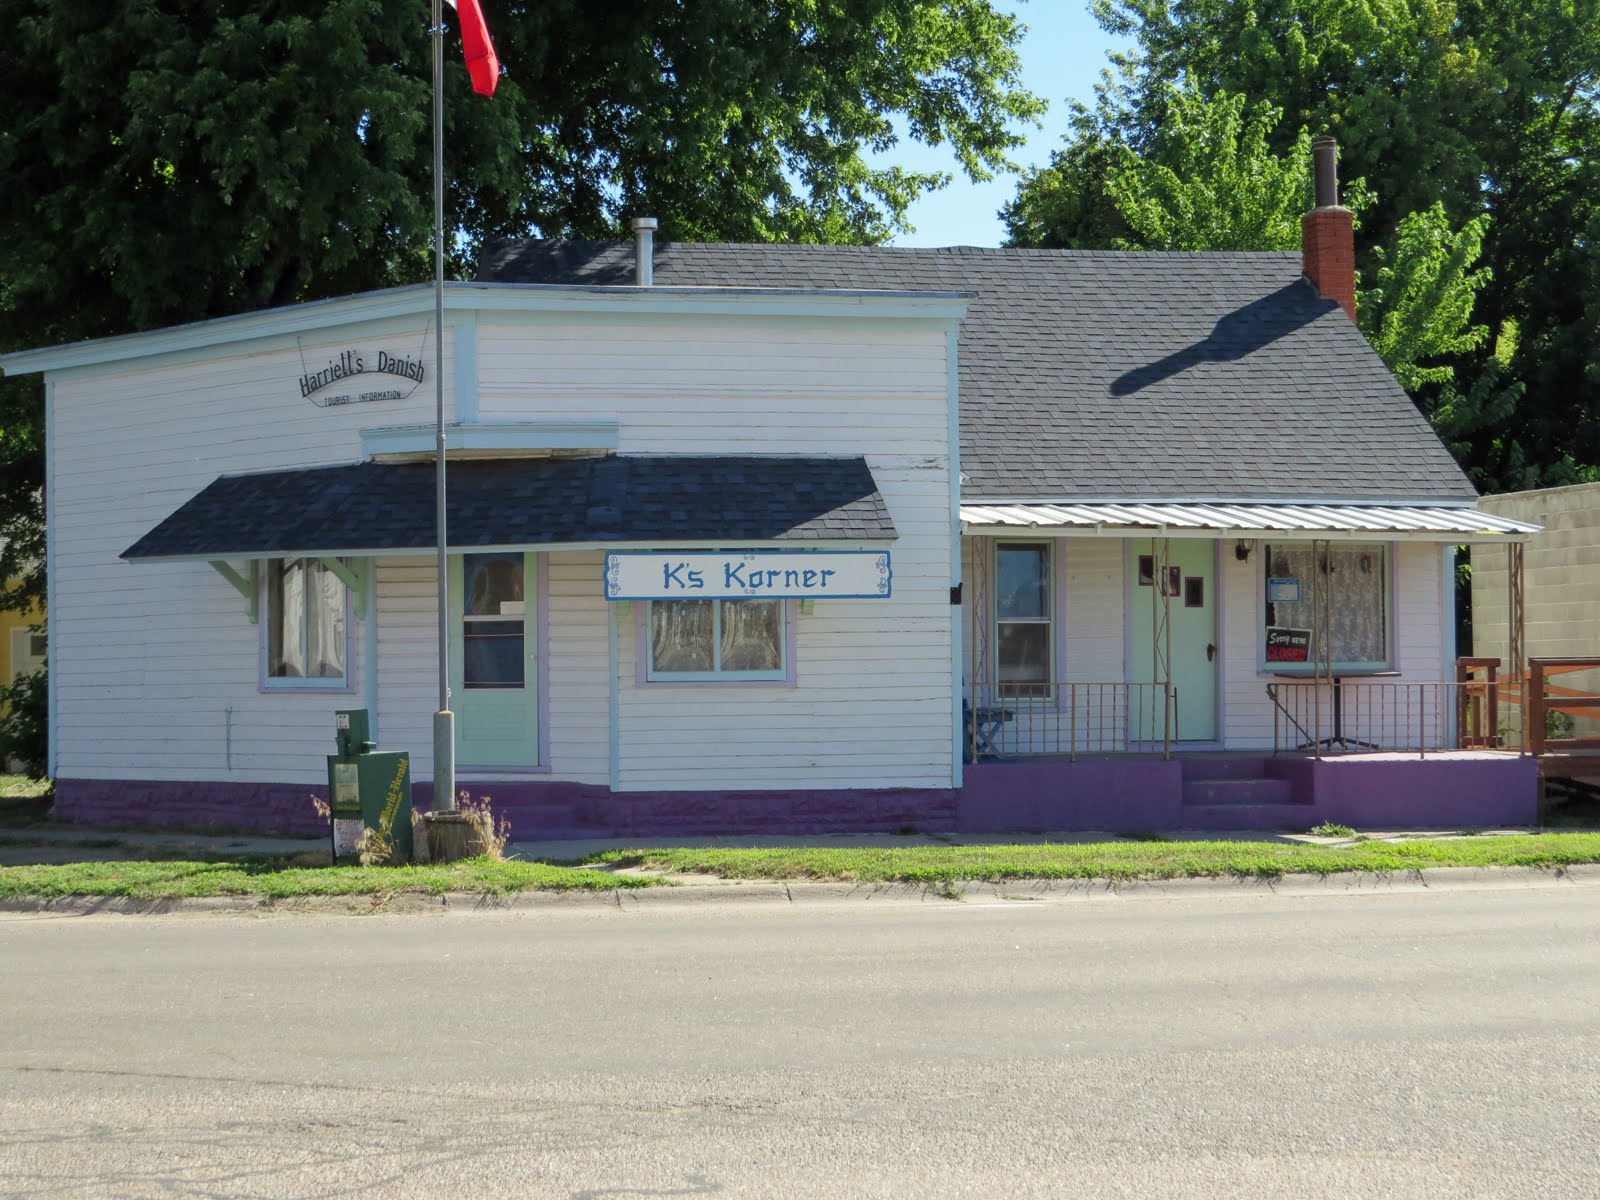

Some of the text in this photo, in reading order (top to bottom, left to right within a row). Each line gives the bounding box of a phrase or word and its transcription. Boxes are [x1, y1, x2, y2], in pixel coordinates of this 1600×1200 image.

[299, 350, 425, 398] Harriett's Danish
[324, 390, 401, 407] TOURIST INFORMATION
[663, 562, 836, 589] K's Korner
[1269, 632, 1290, 644] Sorry
